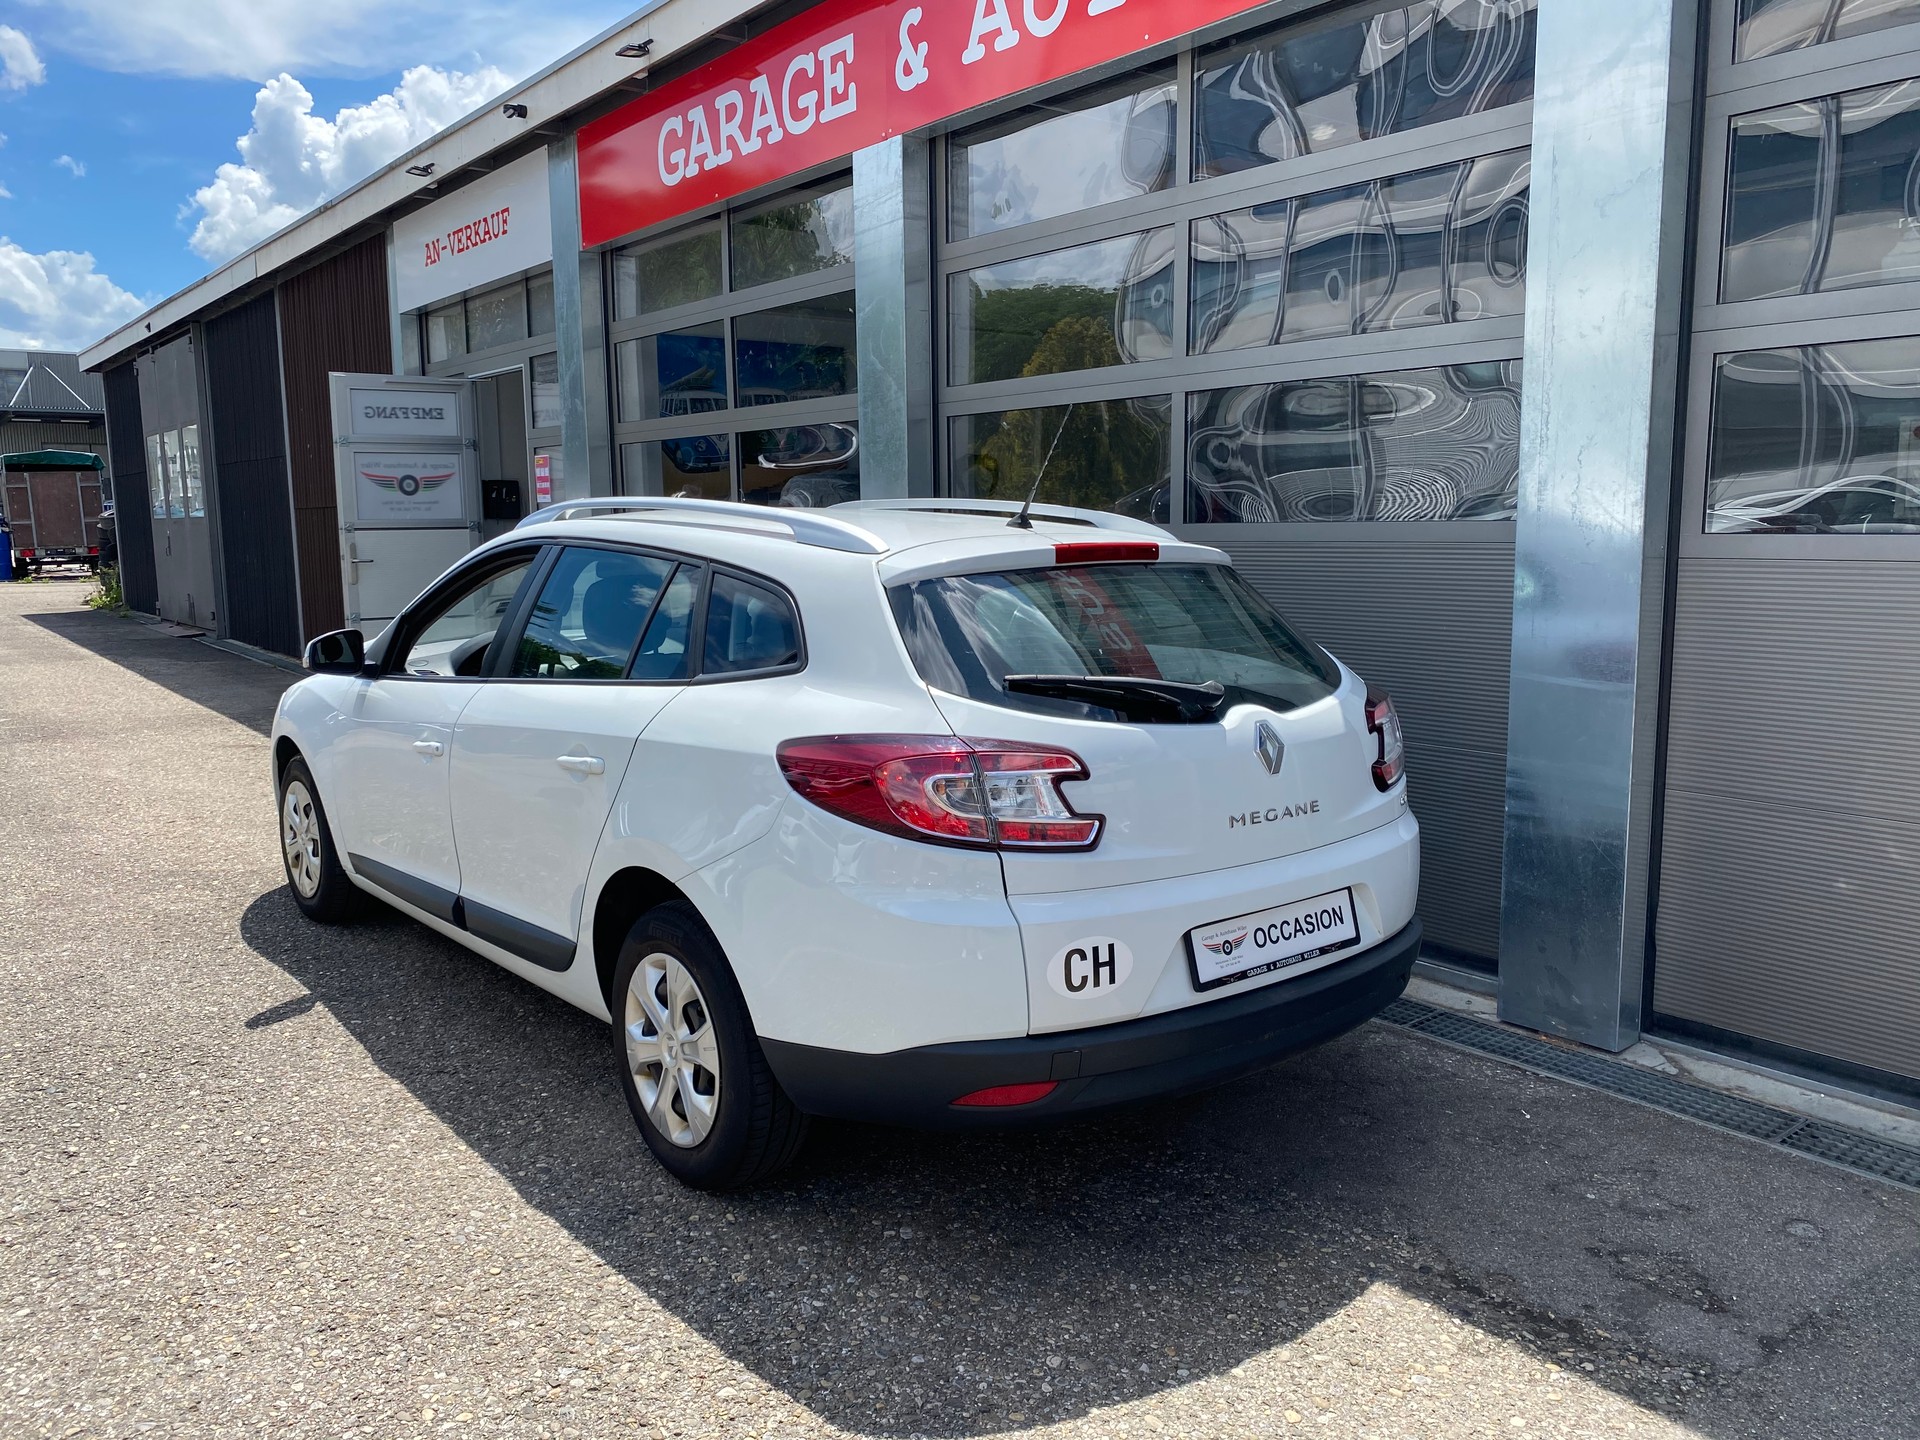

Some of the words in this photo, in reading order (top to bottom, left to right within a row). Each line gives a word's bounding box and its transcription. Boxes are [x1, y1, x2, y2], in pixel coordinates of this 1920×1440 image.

[657, 33, 857, 187] GARAGE
[895, 6, 929, 92] &
[424, 206, 510, 267] AN-VERKAUF
[1228, 800, 1320, 829] MEGANE
[1253, 905, 1345, 949] OCCASION
[1063, 942, 1116, 993] CH
[1246, 965, 1268, 977] GARAGE
[1276, 955, 1302, 968] AUTOHAUS
[1303, 949, 1320, 960] WILER
